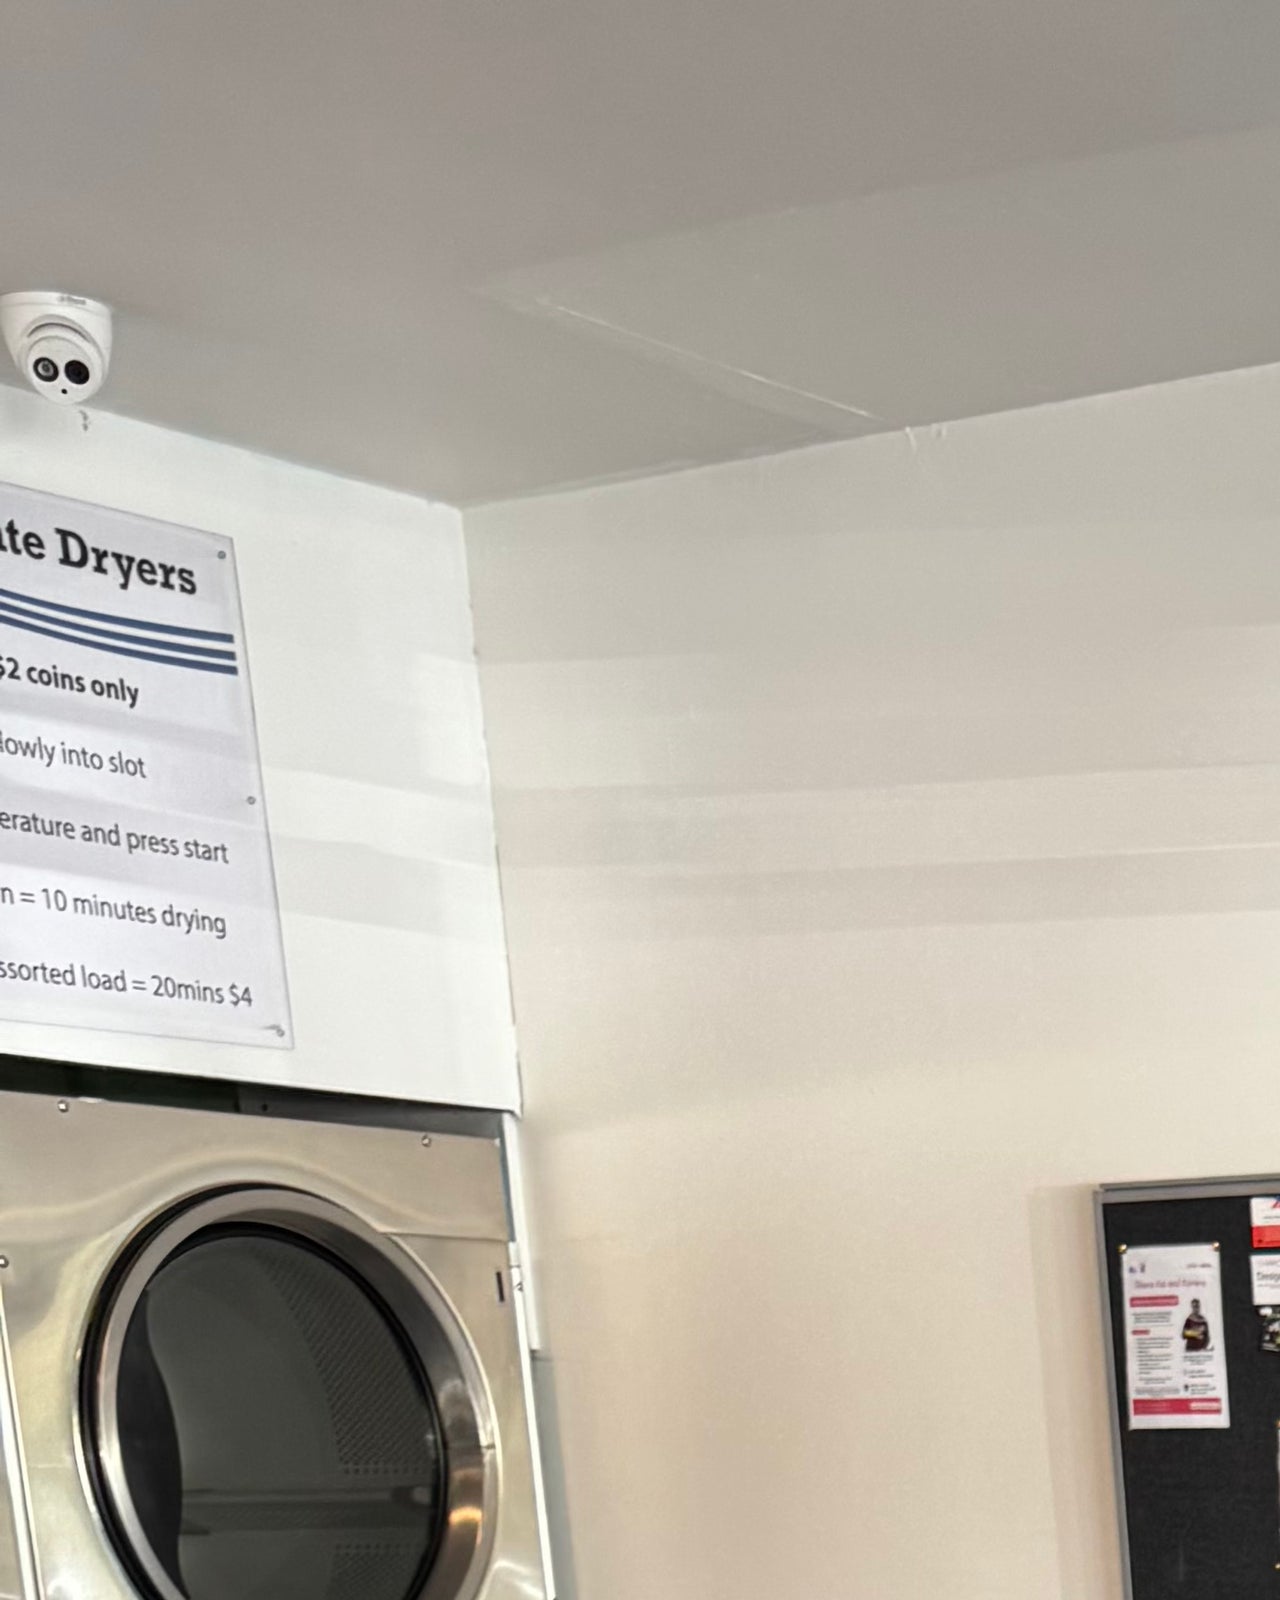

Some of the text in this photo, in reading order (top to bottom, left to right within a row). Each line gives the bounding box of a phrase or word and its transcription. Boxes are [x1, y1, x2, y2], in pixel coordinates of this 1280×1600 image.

[54, 527, 197, 595] Dryers
[26, 664, 86, 693] coins
[91, 678, 139, 709] only
[61, 742, 104, 770] into
[109, 751, 147, 778] slot
[81, 823, 122, 847] and
[127, 830, 180, 854] press
[184, 838, 230, 864] start
[41, 887, 68, 912] 10
[73, 894, 158, 925] minutes
[162, 904, 227, 940] drying
[81, 964, 128, 993] load
[151, 975, 225, 1006] 20mins
[229, 983, 254, 1008] $4
